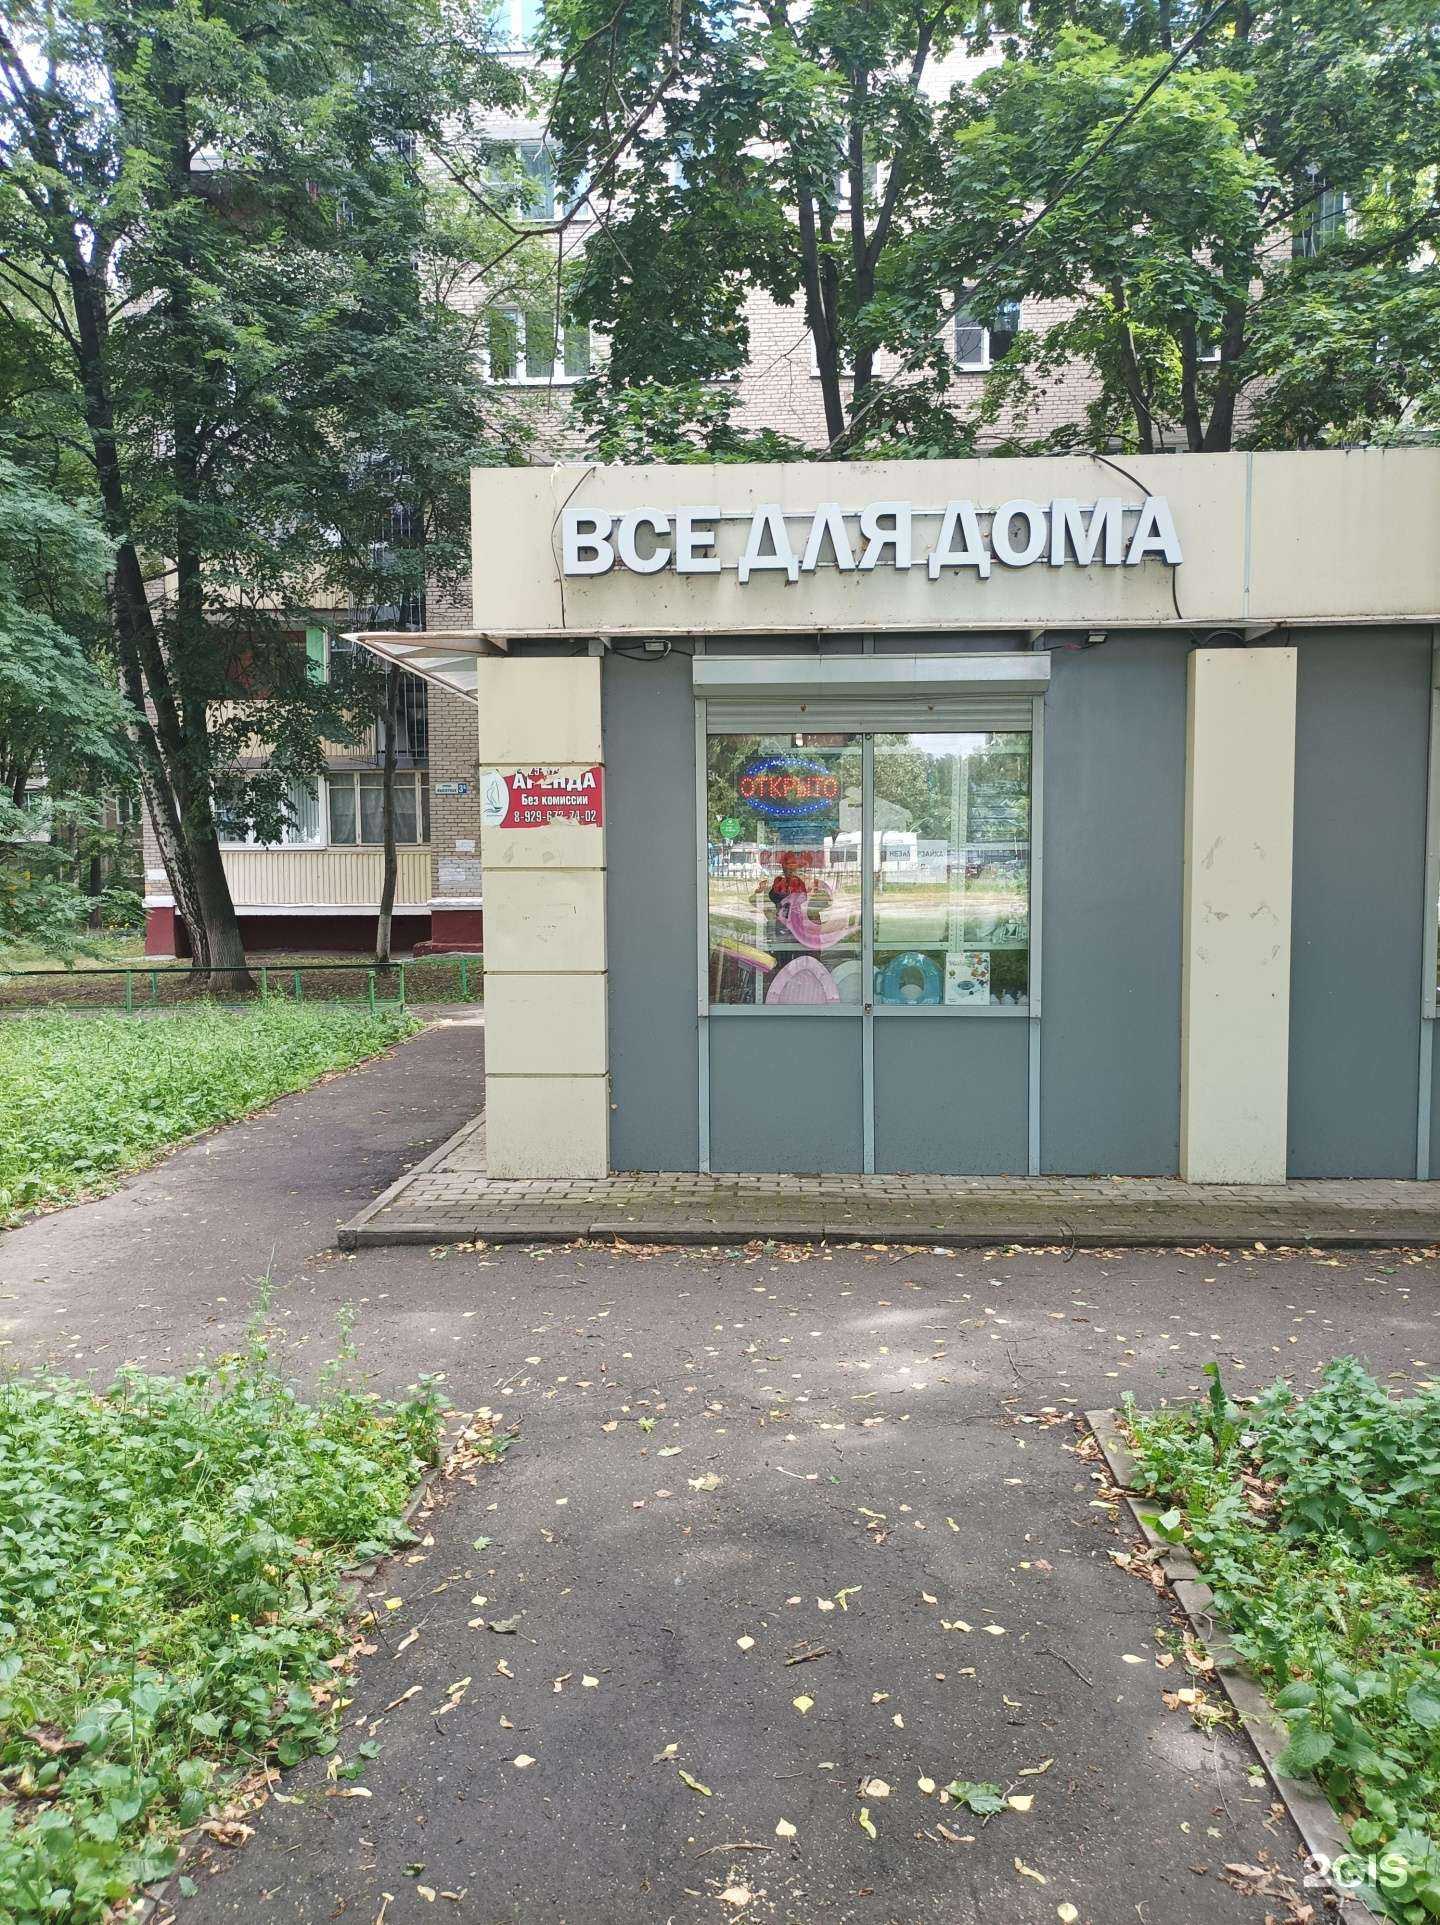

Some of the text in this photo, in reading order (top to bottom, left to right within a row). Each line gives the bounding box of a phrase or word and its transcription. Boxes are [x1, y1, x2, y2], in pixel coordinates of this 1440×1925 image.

[562, 496, 1184, 585] ВСЕ ДЛЯ ДОМА
[739, 775, 839, 799] ОТКРЫТО
[521, 794, 589, 805] Без комиссии
